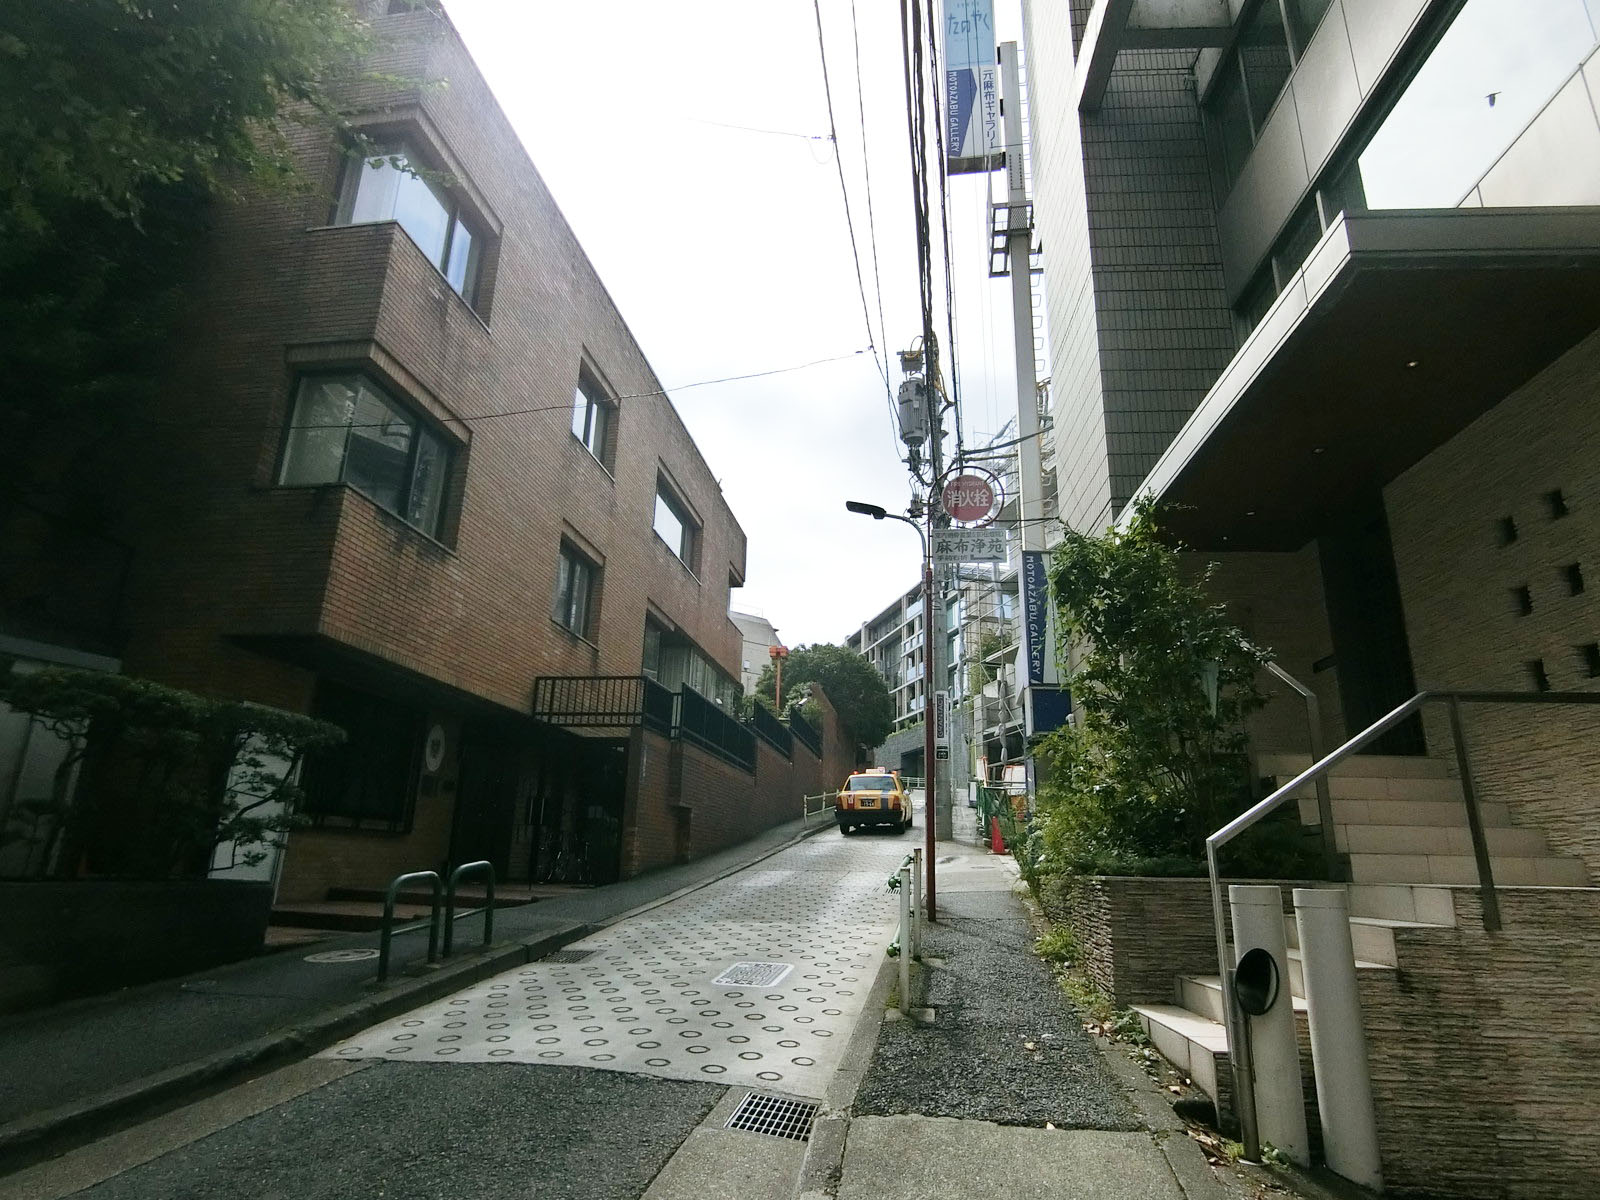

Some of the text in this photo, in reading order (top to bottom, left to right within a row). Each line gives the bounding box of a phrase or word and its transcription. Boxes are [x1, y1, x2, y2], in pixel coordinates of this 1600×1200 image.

[948, 71, 960, 152] MOTOAZABU GALLERY
[983, 69, 996, 148] 元麻布ギャラリー
[947, 488, 989, 508] 消火栓
[1026, 555, 1041, 675] MOTOAZABU GALLERY
